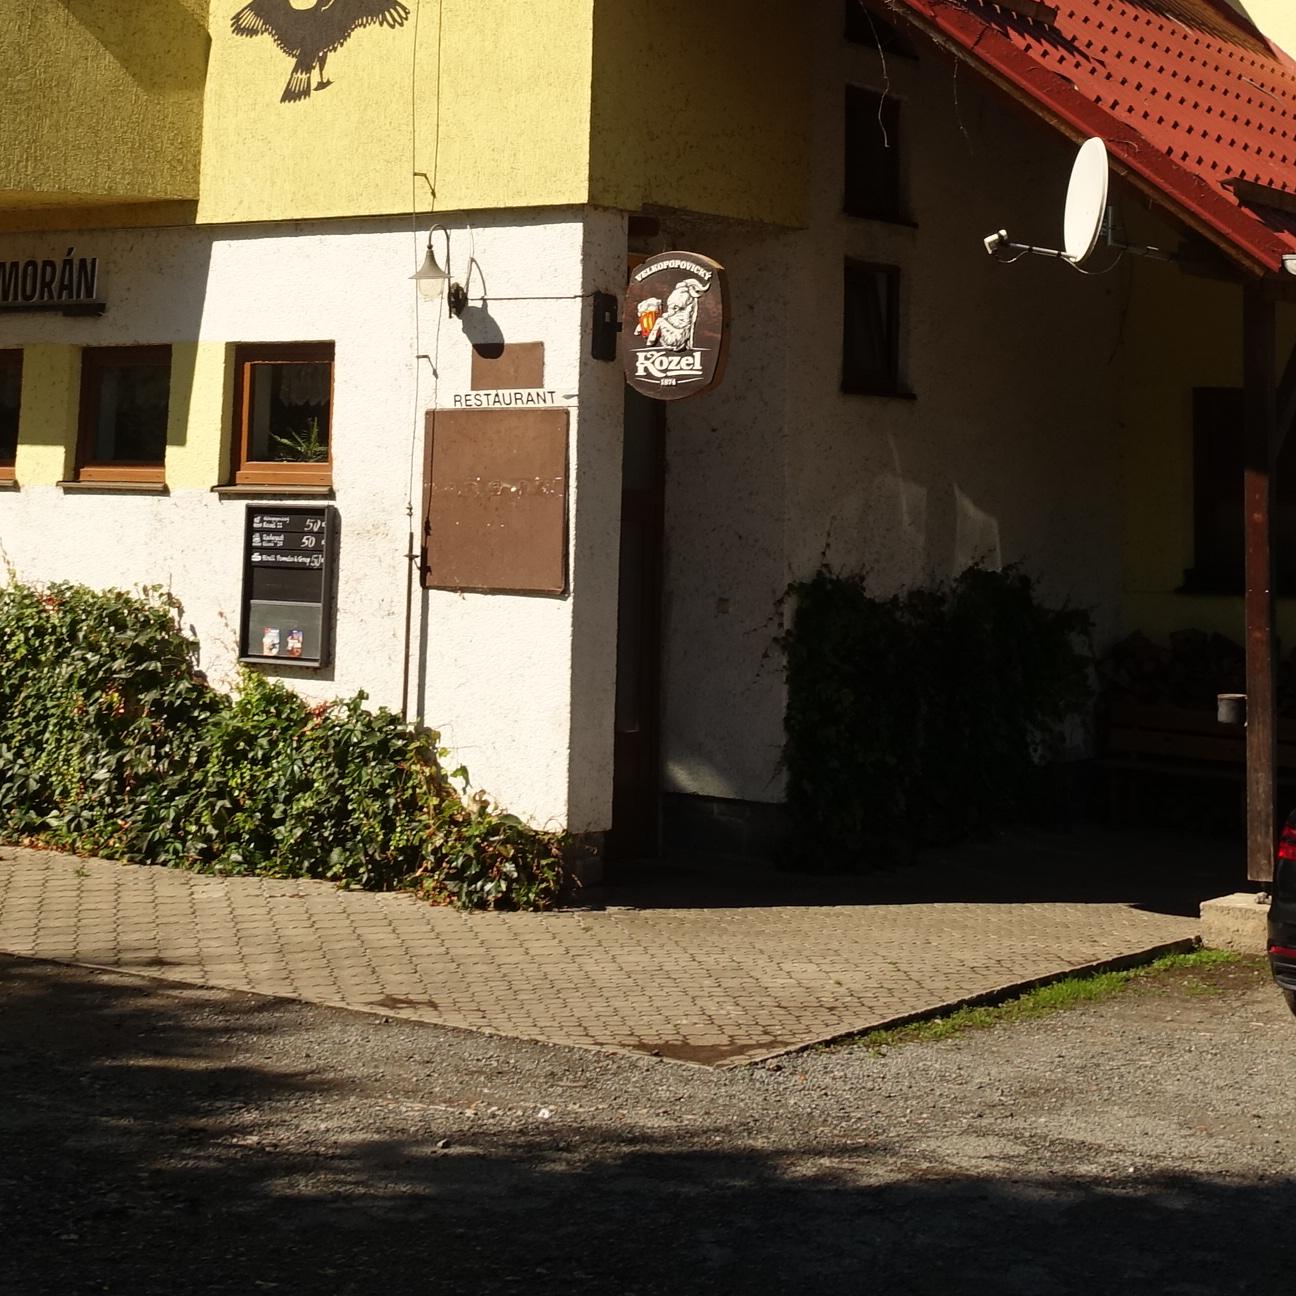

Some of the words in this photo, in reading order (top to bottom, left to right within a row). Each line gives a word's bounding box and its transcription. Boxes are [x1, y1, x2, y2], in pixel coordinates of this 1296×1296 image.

[634, 259, 712, 282] VELKOPOPOVICKÝ
[634, 351, 703, 377] Kozel
[453, 391, 556, 407] RESTAURANT
[300, 535, 316, 548] 50
